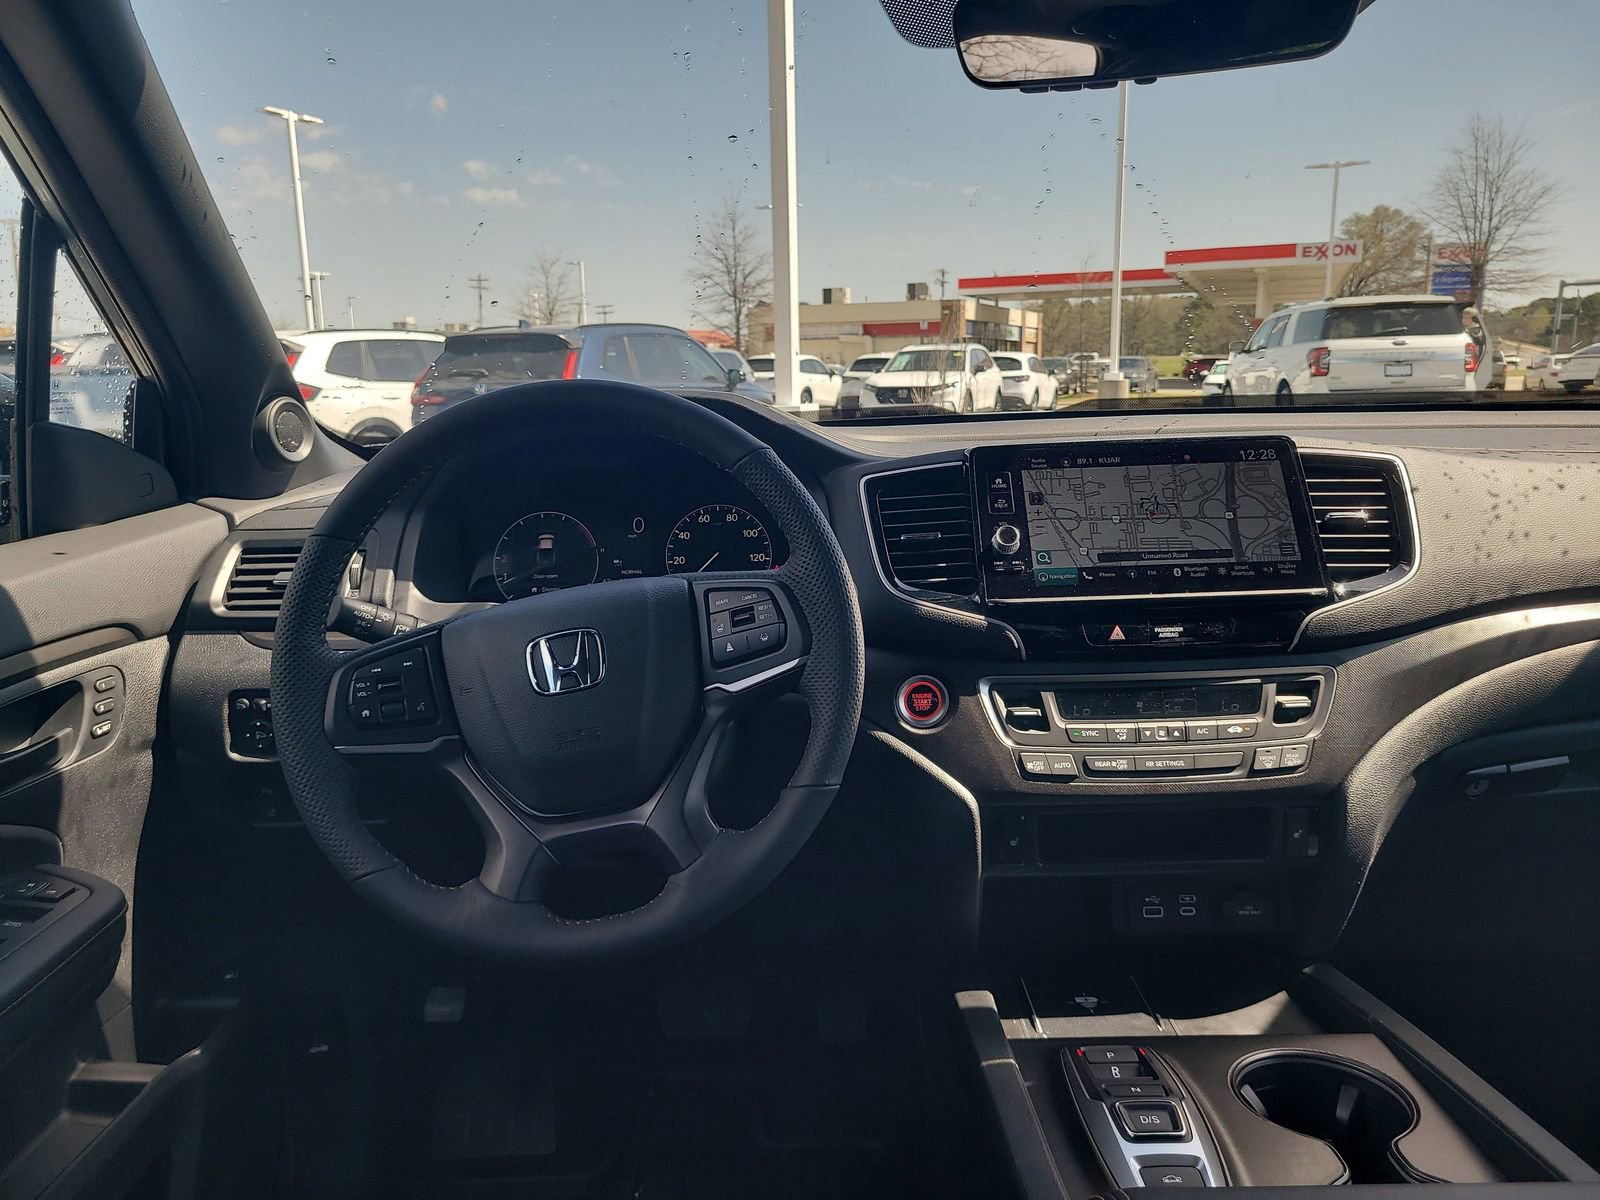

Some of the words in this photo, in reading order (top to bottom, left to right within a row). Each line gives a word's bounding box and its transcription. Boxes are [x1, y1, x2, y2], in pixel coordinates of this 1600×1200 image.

[1302, 244, 1356, 261] EXXON
[1240, 449, 1276, 460] 12:28
[698, 514, 710, 523] 60
[726, 513, 738, 522] 80
[633, 517, 645, 533] 0
[678, 531, 690, 540] 40
[742, 529, 758, 538] 100
[673, 556, 686, 565] 20
[750, 553, 765, 562] 120
[1050, 572, 1076, 580] Navigation
[715, 598, 729, 606] MAIN
[353, 610, 371, 619] AUTO
[1111, 1066, 1121, 1078] R
[1139, 1115, 1160, 1124] D/S
